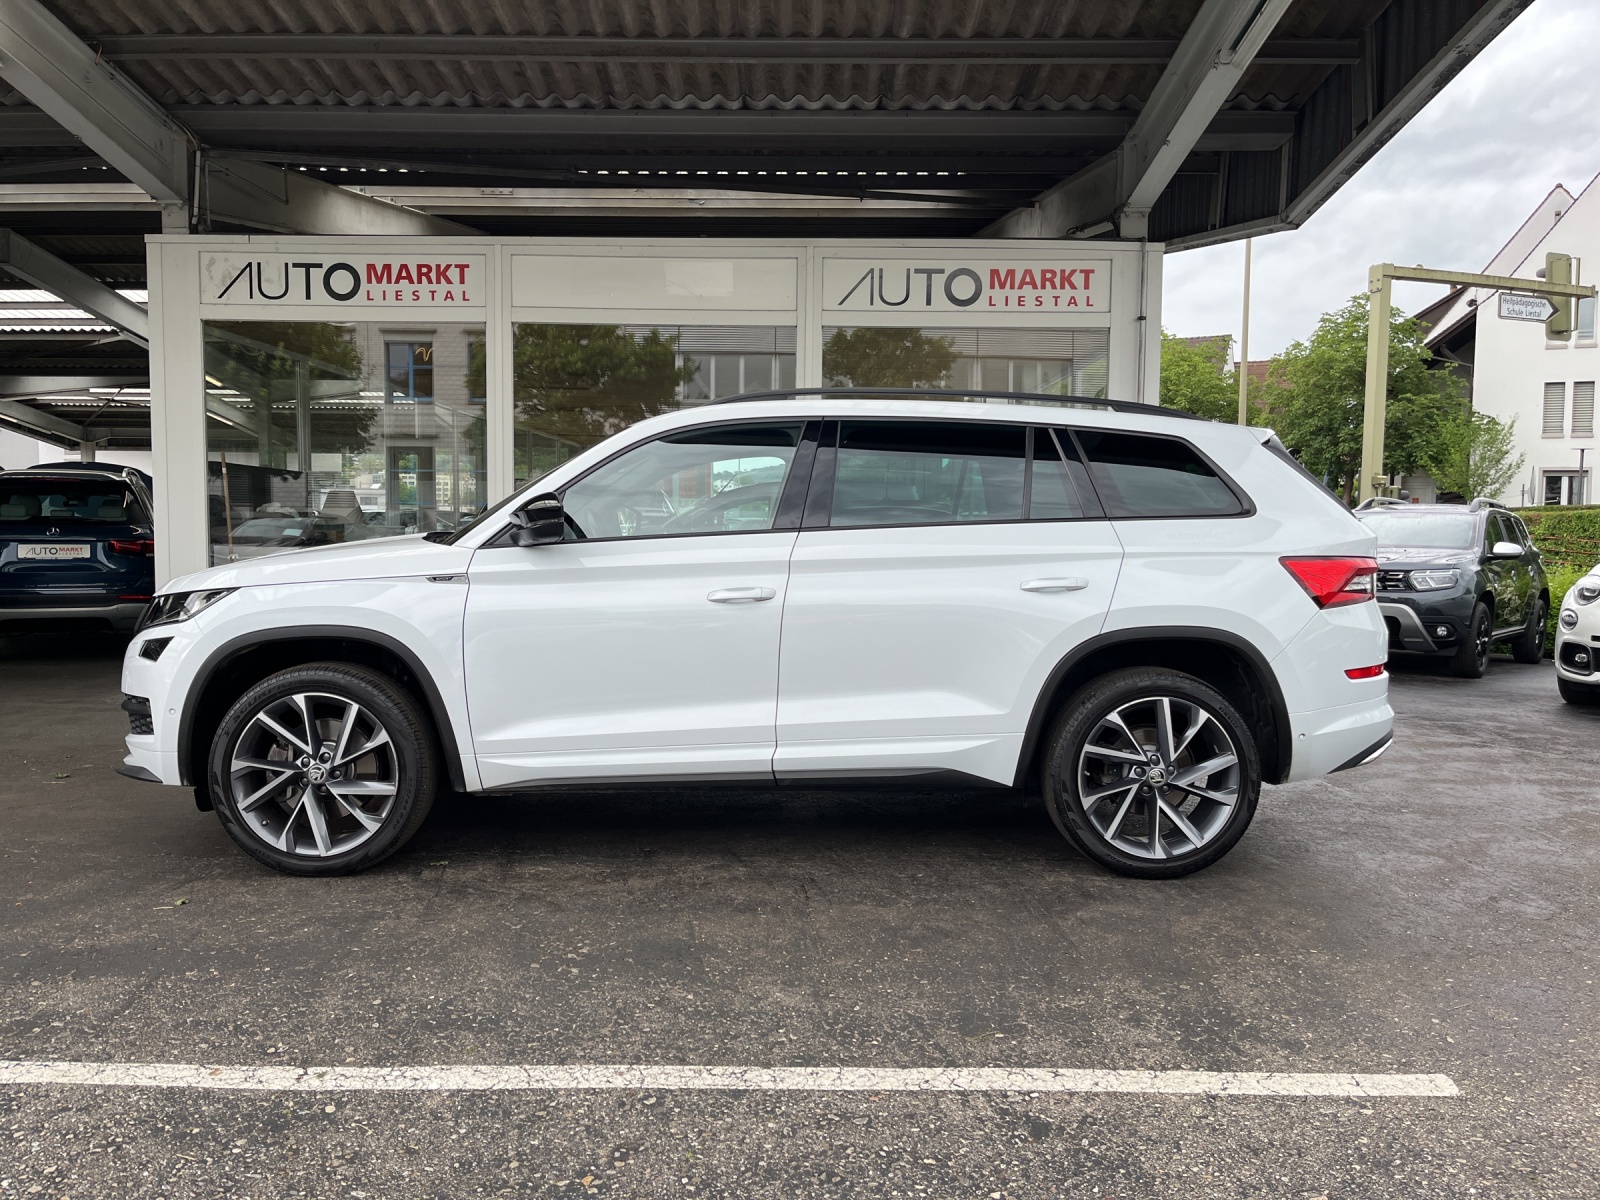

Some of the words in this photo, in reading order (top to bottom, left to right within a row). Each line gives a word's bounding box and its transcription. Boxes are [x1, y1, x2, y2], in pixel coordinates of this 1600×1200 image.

[366, 263, 470, 285] MARKT
[988, 268, 1096, 290] MARKT
[366, 290, 470, 302] LIESTAL
[988, 295, 1095, 307] LIESTAL
[1503, 297, 1546, 309] Heilpädagogische
[1507, 307, 1523, 316] Schule
[1526, 309, 1542, 317] Liestal
